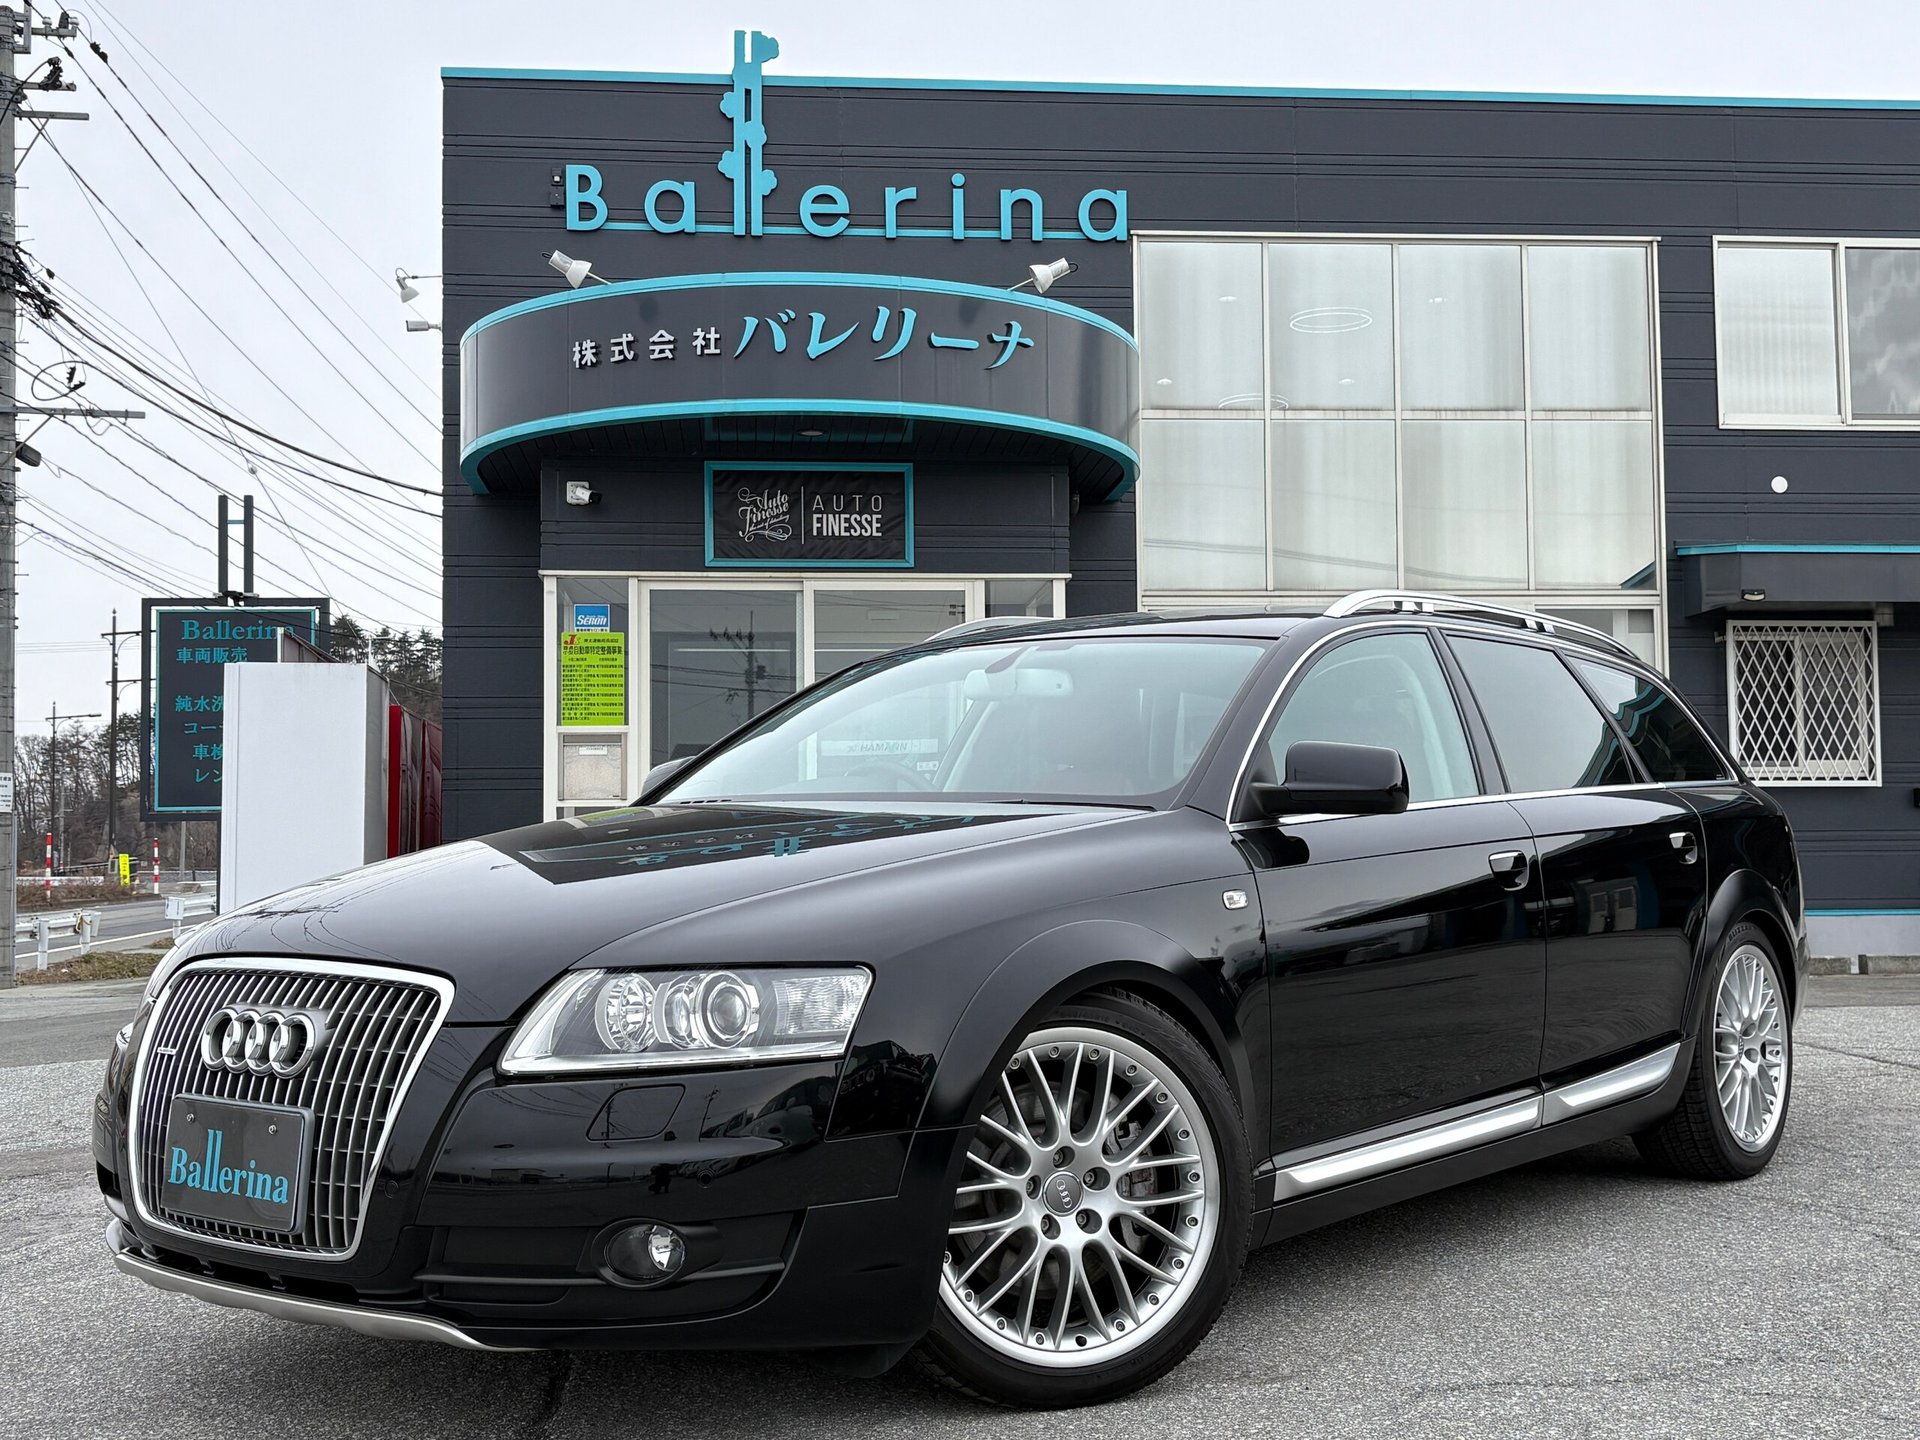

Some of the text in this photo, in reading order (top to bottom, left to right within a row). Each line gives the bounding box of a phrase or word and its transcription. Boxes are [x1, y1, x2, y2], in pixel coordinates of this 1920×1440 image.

[564, 30, 1130, 243] Ballerina
[812, 495, 883, 512] AUTO
[812, 513, 882, 537] FINESSE
[176, 647, 247, 664] 車両販売
[167, 1129, 289, 1205] Ballerina
